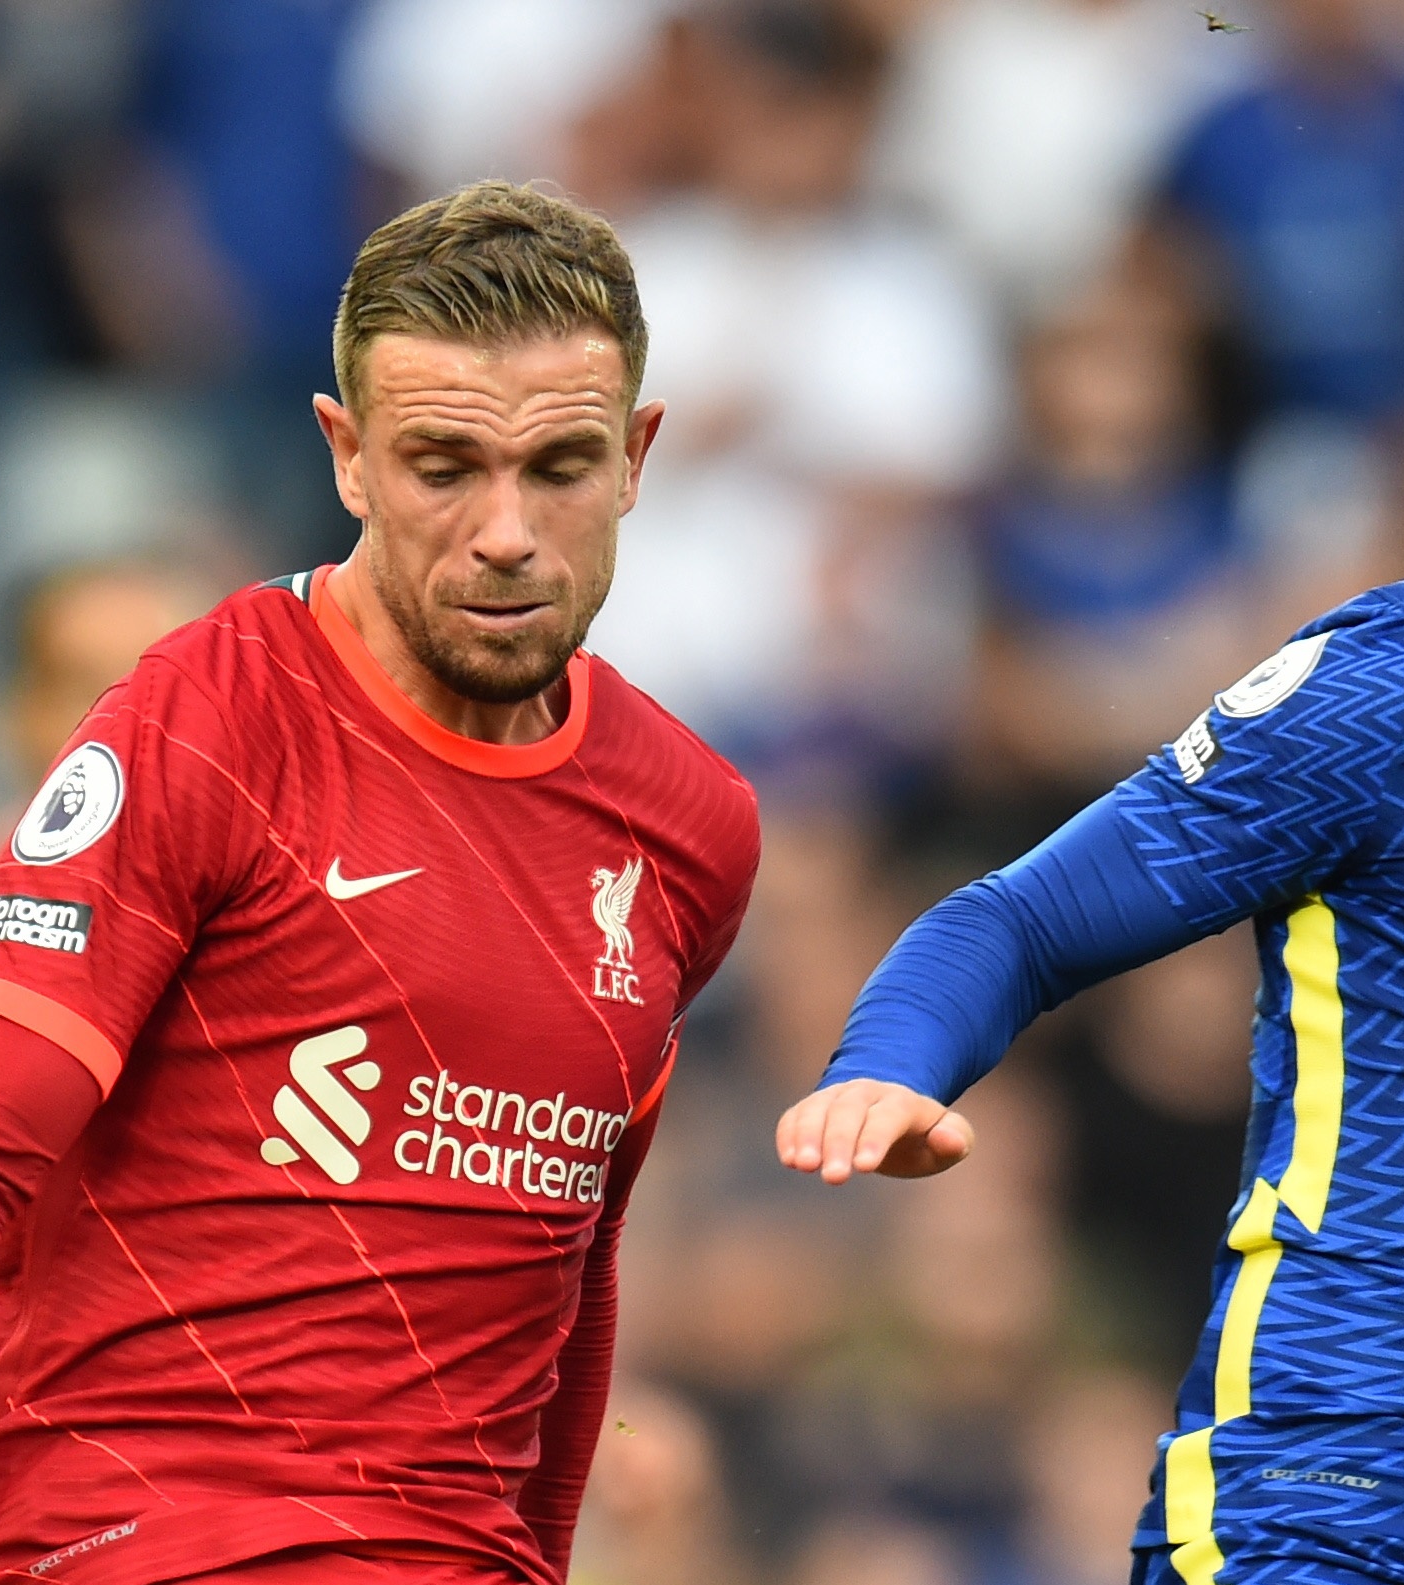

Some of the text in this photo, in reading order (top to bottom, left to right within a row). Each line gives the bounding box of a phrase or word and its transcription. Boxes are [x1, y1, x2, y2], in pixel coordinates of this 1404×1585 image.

[8, 898, 78, 929] room
[0, 919, 86, 955] racism
[403, 1068, 633, 1153] standard
